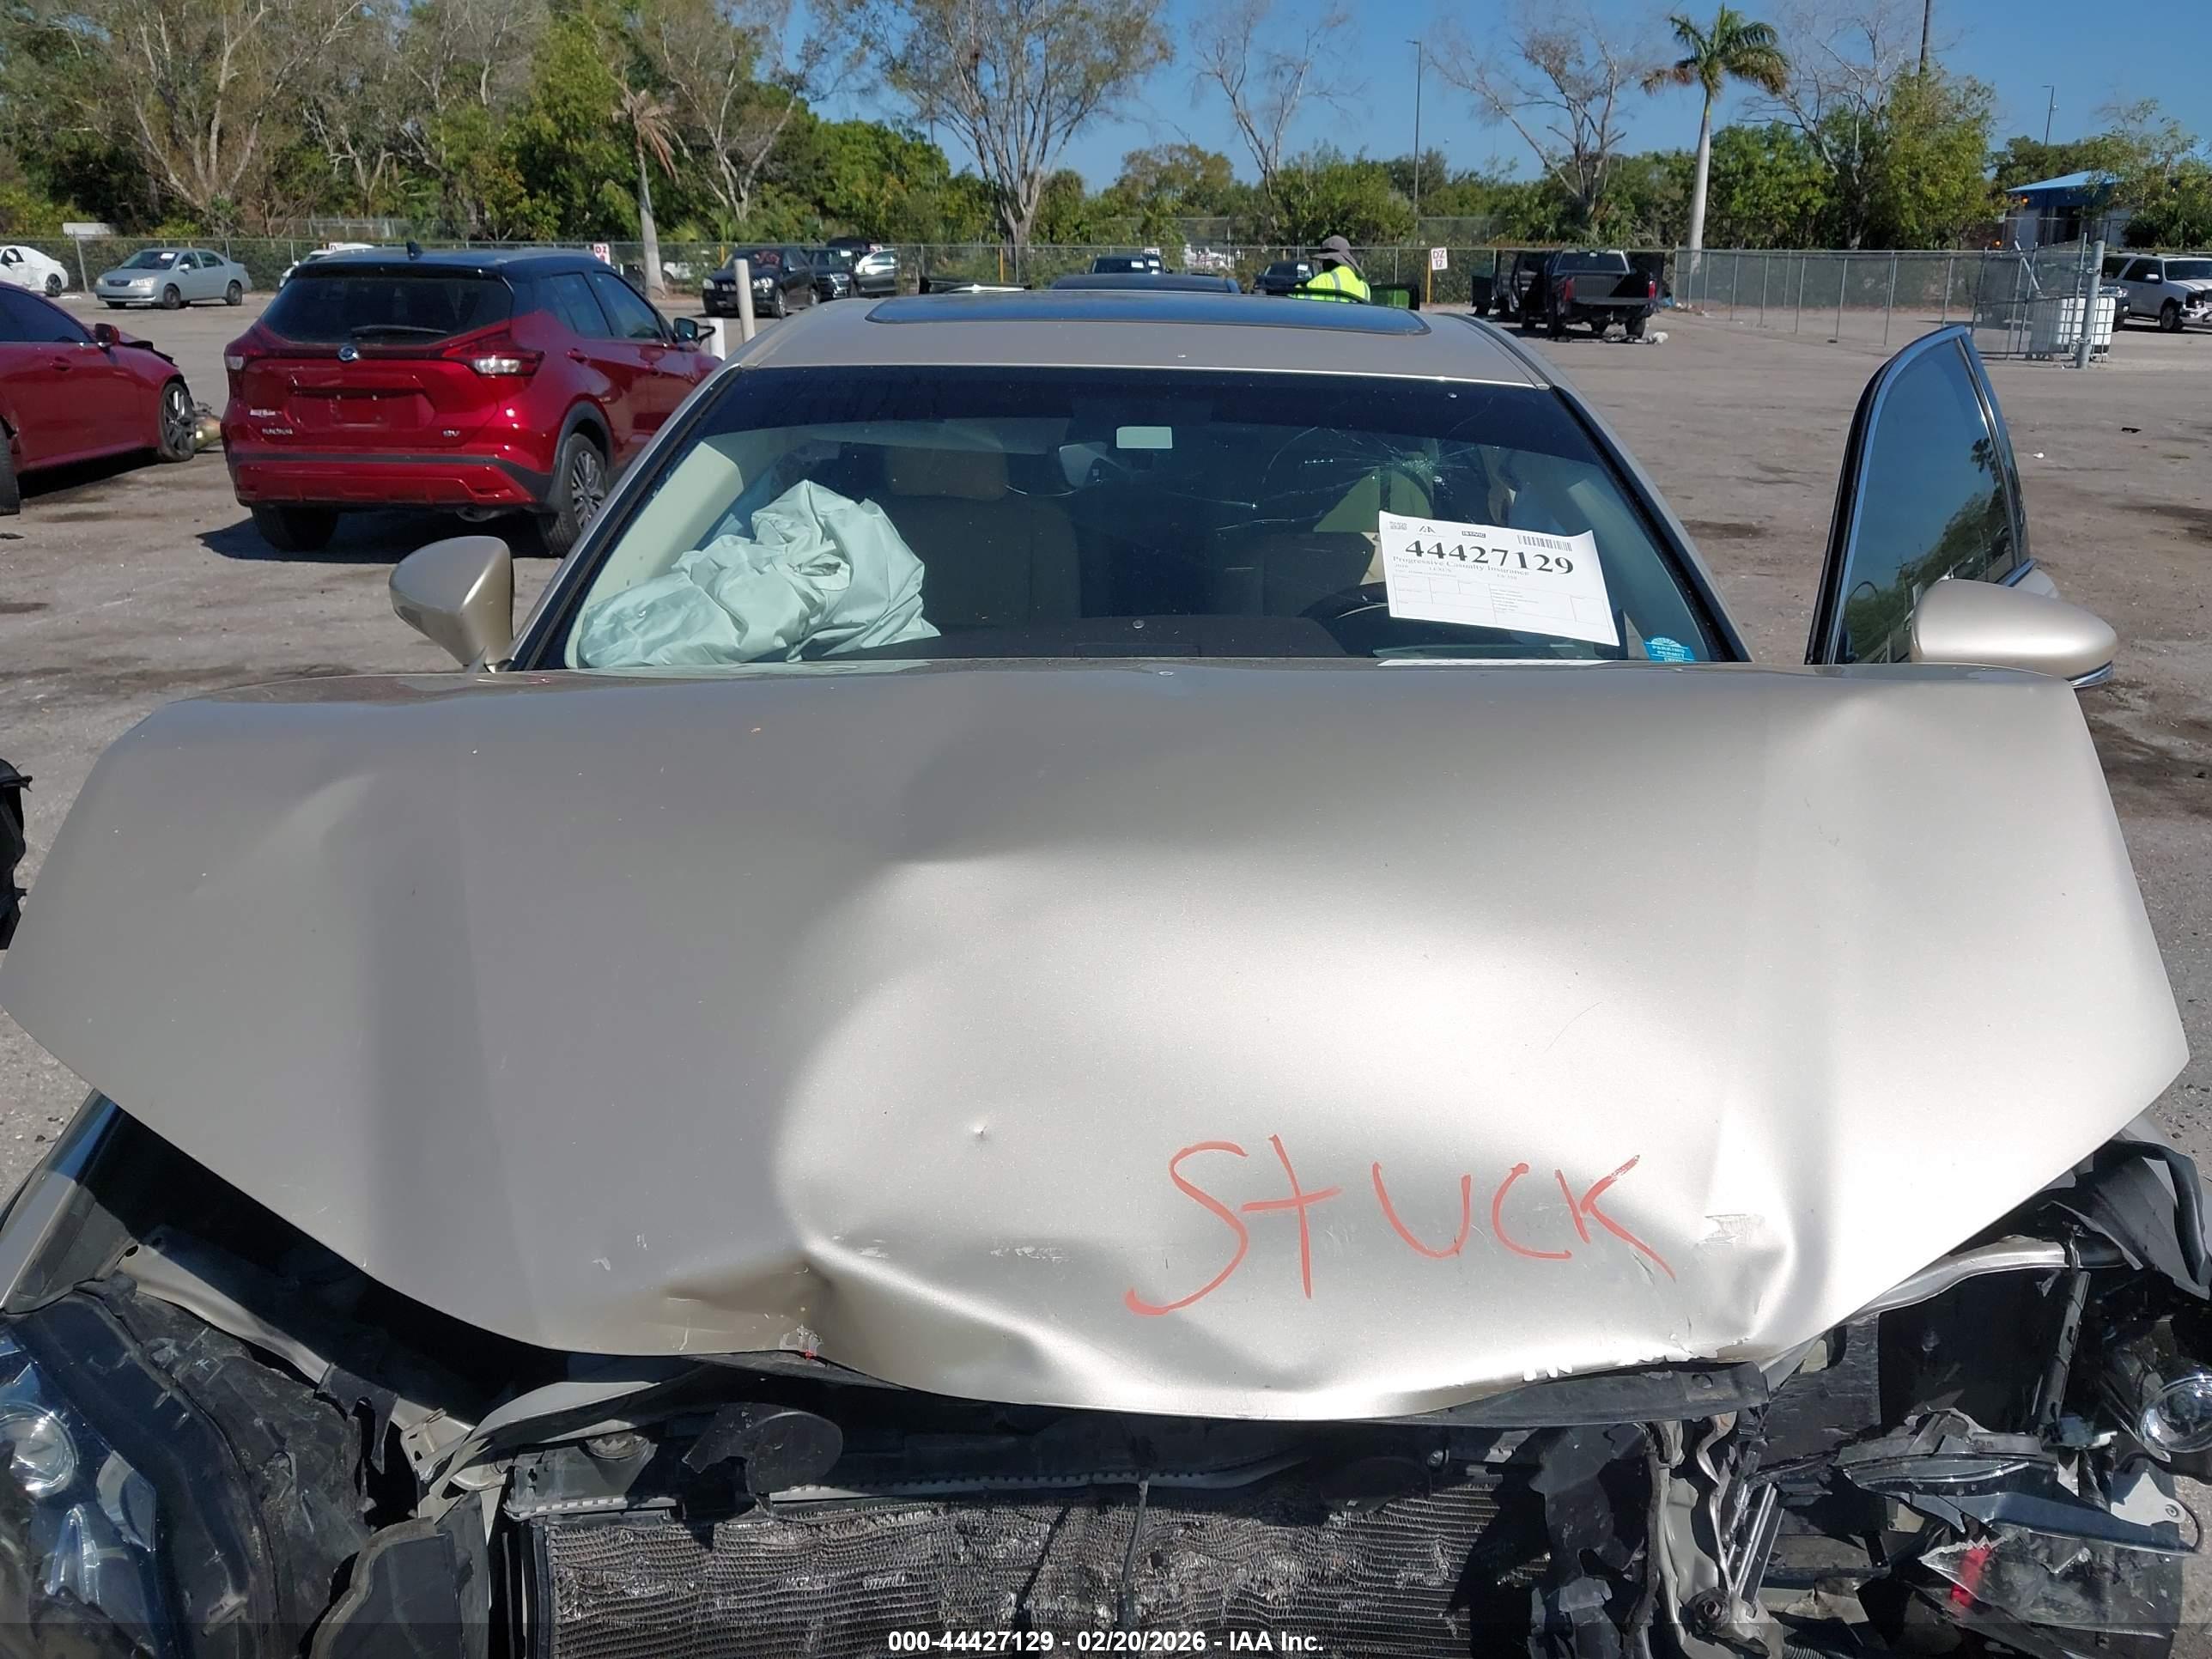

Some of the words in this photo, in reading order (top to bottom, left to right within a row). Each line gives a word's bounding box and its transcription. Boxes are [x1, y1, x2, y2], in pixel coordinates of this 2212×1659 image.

[1433, 250, 1444, 258] DZ
[1393, 556, 1444, 566] Progressive
[1446, 561, 1484, 571] Casualty
[1487, 565, 1530, 576] Insurance
[1405, 539, 1574, 574] 44427129
